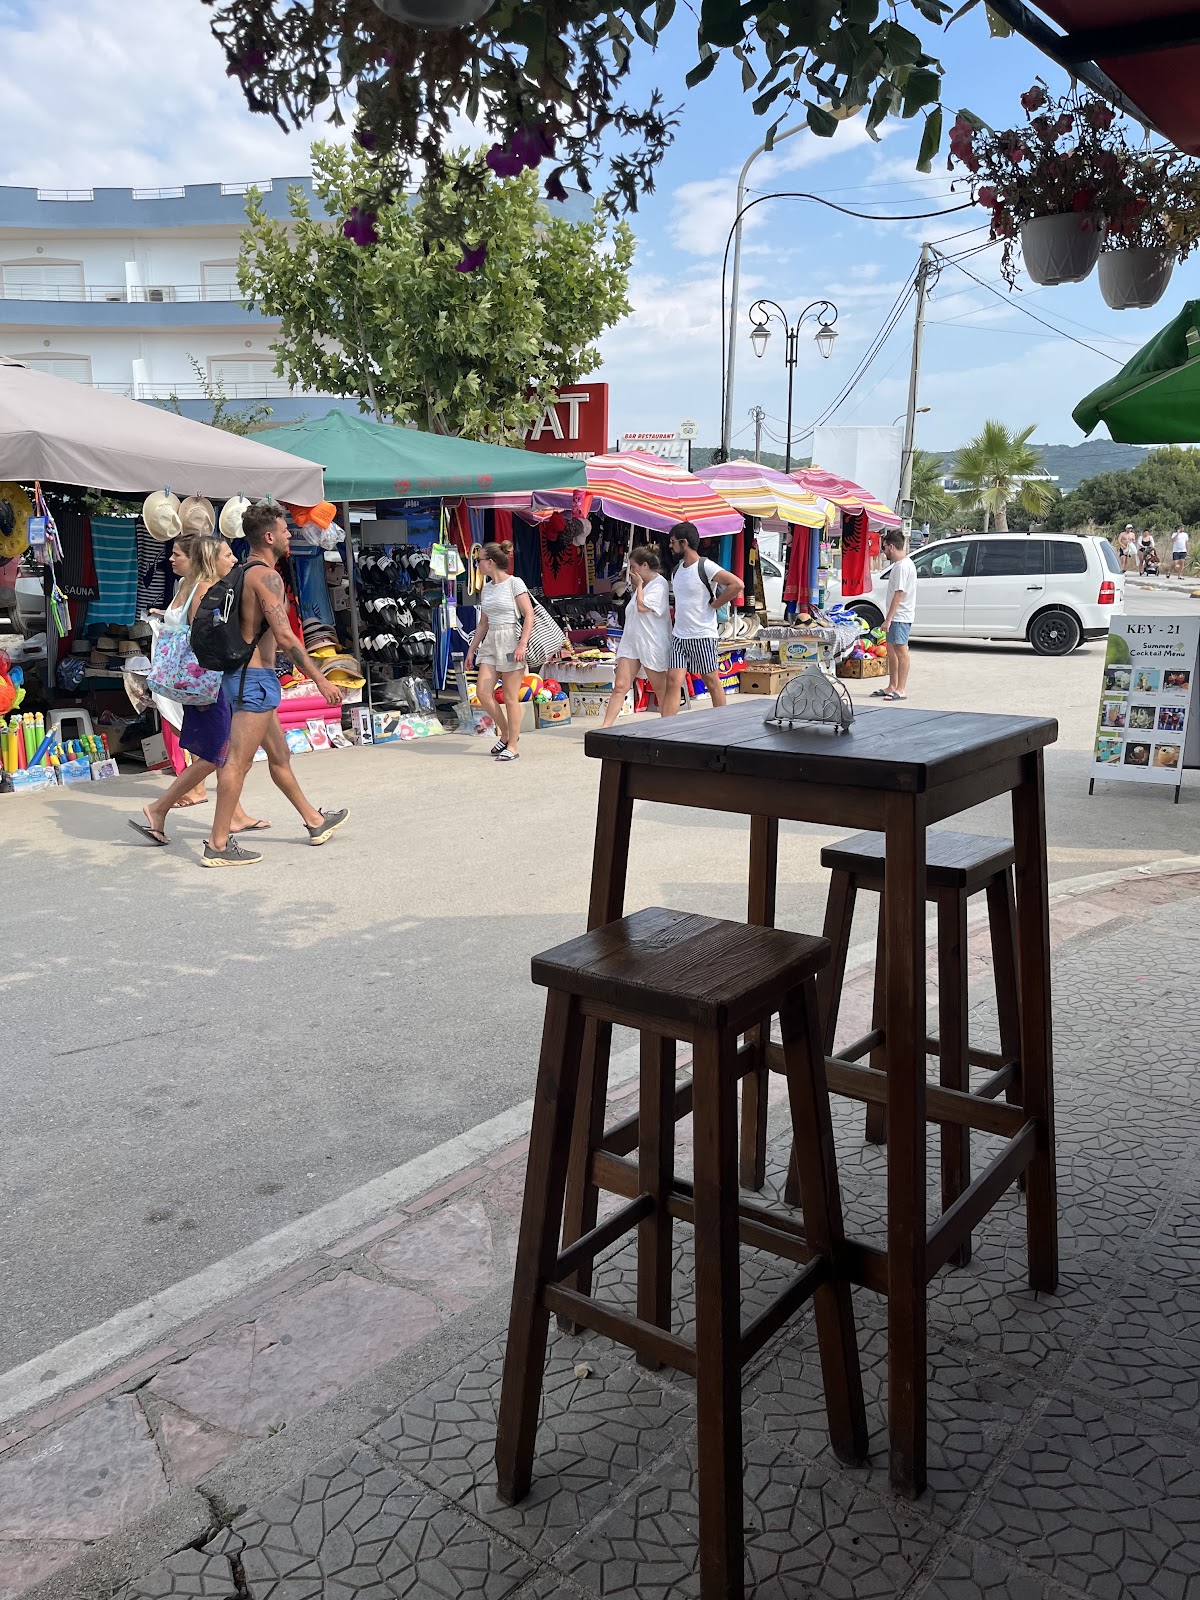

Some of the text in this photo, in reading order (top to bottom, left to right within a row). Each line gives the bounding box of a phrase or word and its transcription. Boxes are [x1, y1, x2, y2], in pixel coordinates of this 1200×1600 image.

[64, 585, 95, 596] SAUNA
[1127, 624, 1156, 634] KEY
[1167, 624, 1180, 634] 21
[1130, 649, 1162, 657] Cocktail
